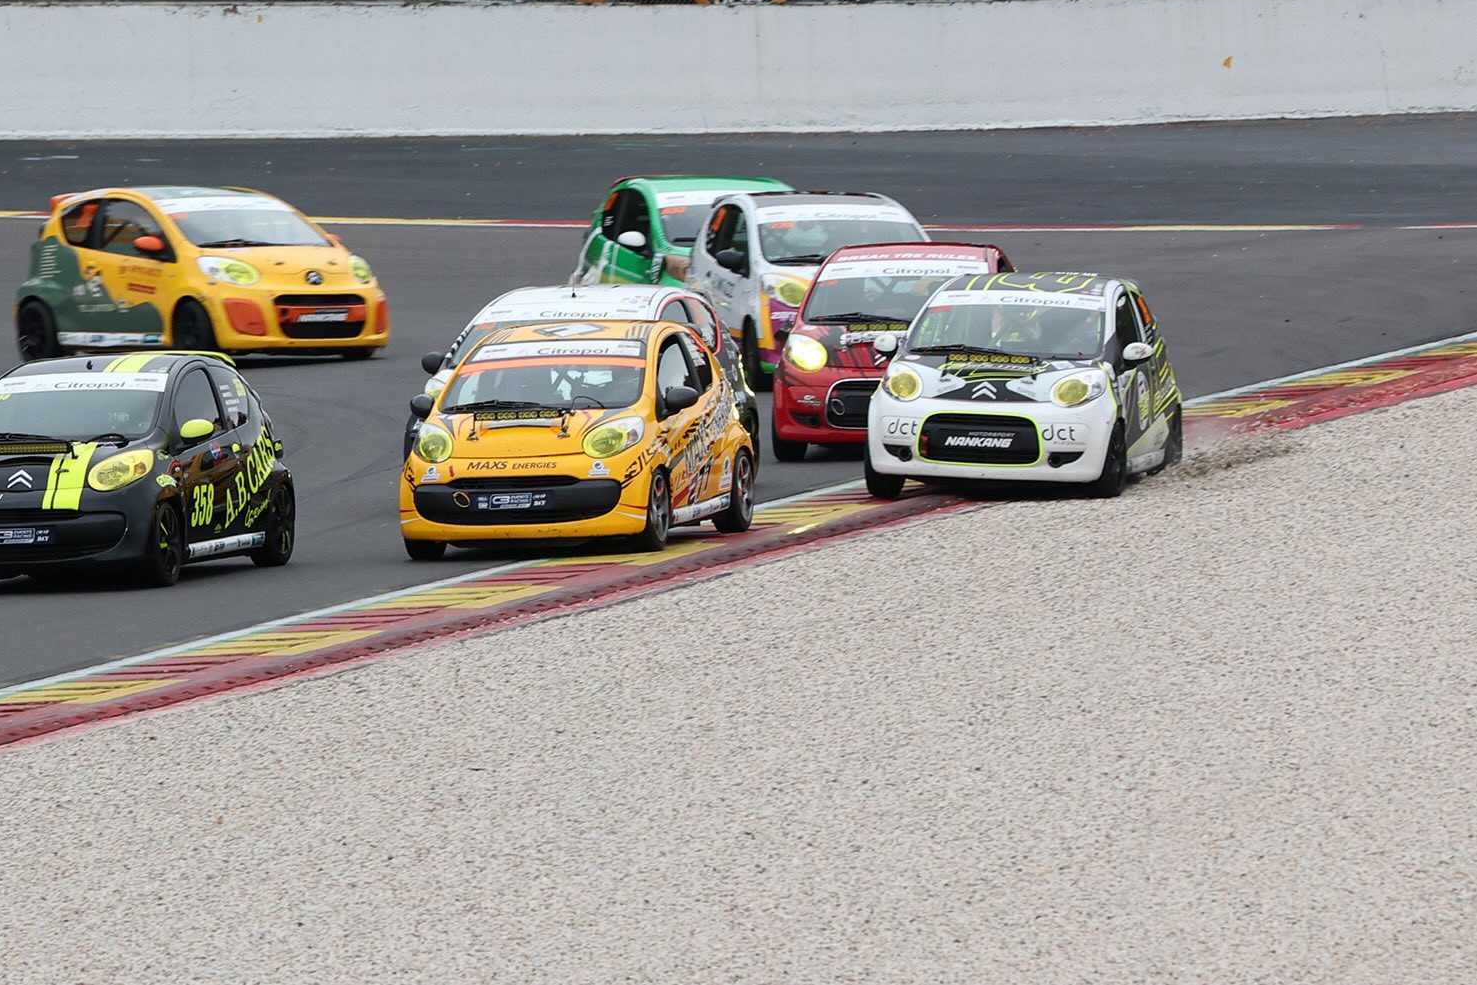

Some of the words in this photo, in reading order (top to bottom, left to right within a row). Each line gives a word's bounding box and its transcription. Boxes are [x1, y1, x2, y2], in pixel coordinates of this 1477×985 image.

[883, 267, 950, 275] Citropol
[1000, 296, 1071, 306] Citropol
[540, 311, 608, 319] Citropol
[537, 348, 609, 356] Citropol
[54, 381, 126, 390] Citropol
[887, 418, 918, 436] dct
[1041, 424, 1076, 441] dct
[945, 436, 1014, 448] NANKANG
[467, 461, 508, 471] MAXS
[512, 462, 557, 470] ENERGIES
[191, 483, 214, 527] 358
